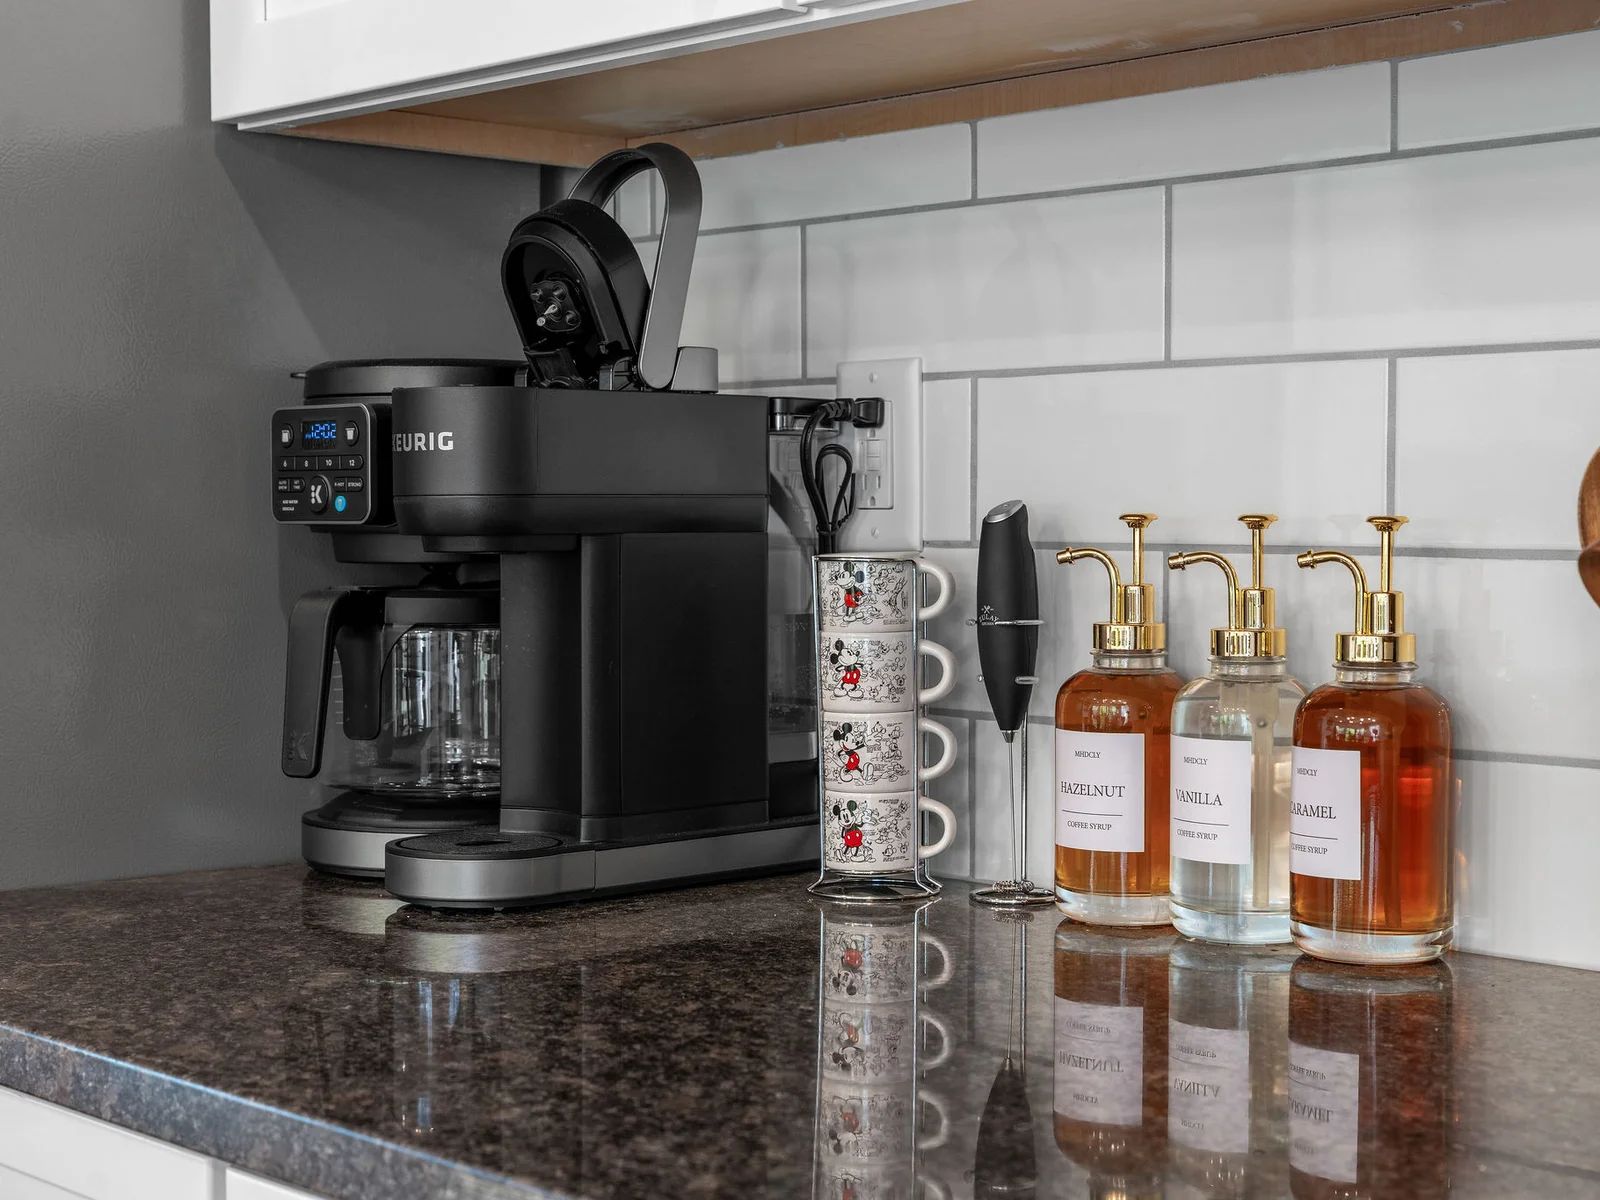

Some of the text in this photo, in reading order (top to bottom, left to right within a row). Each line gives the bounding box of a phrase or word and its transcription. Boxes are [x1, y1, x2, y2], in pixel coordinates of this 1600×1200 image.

[311, 423, 337, 439] 12:02
[283, 460, 288, 468] 6
[304, 460, 309, 468] 8
[325, 459, 333, 467] 10
[348, 459, 355, 467] 12
[1074, 750, 1101, 759] MHDCLY
[1060, 780, 1126, 798] HAZELNUT
[1175, 788, 1223, 806] VANILLA
[1067, 820, 1112, 831] COFFEE SYRUP
[1177, 828, 1218, 841] COFFEE SYRUP
[1307, 845, 1328, 855] SYRUP
